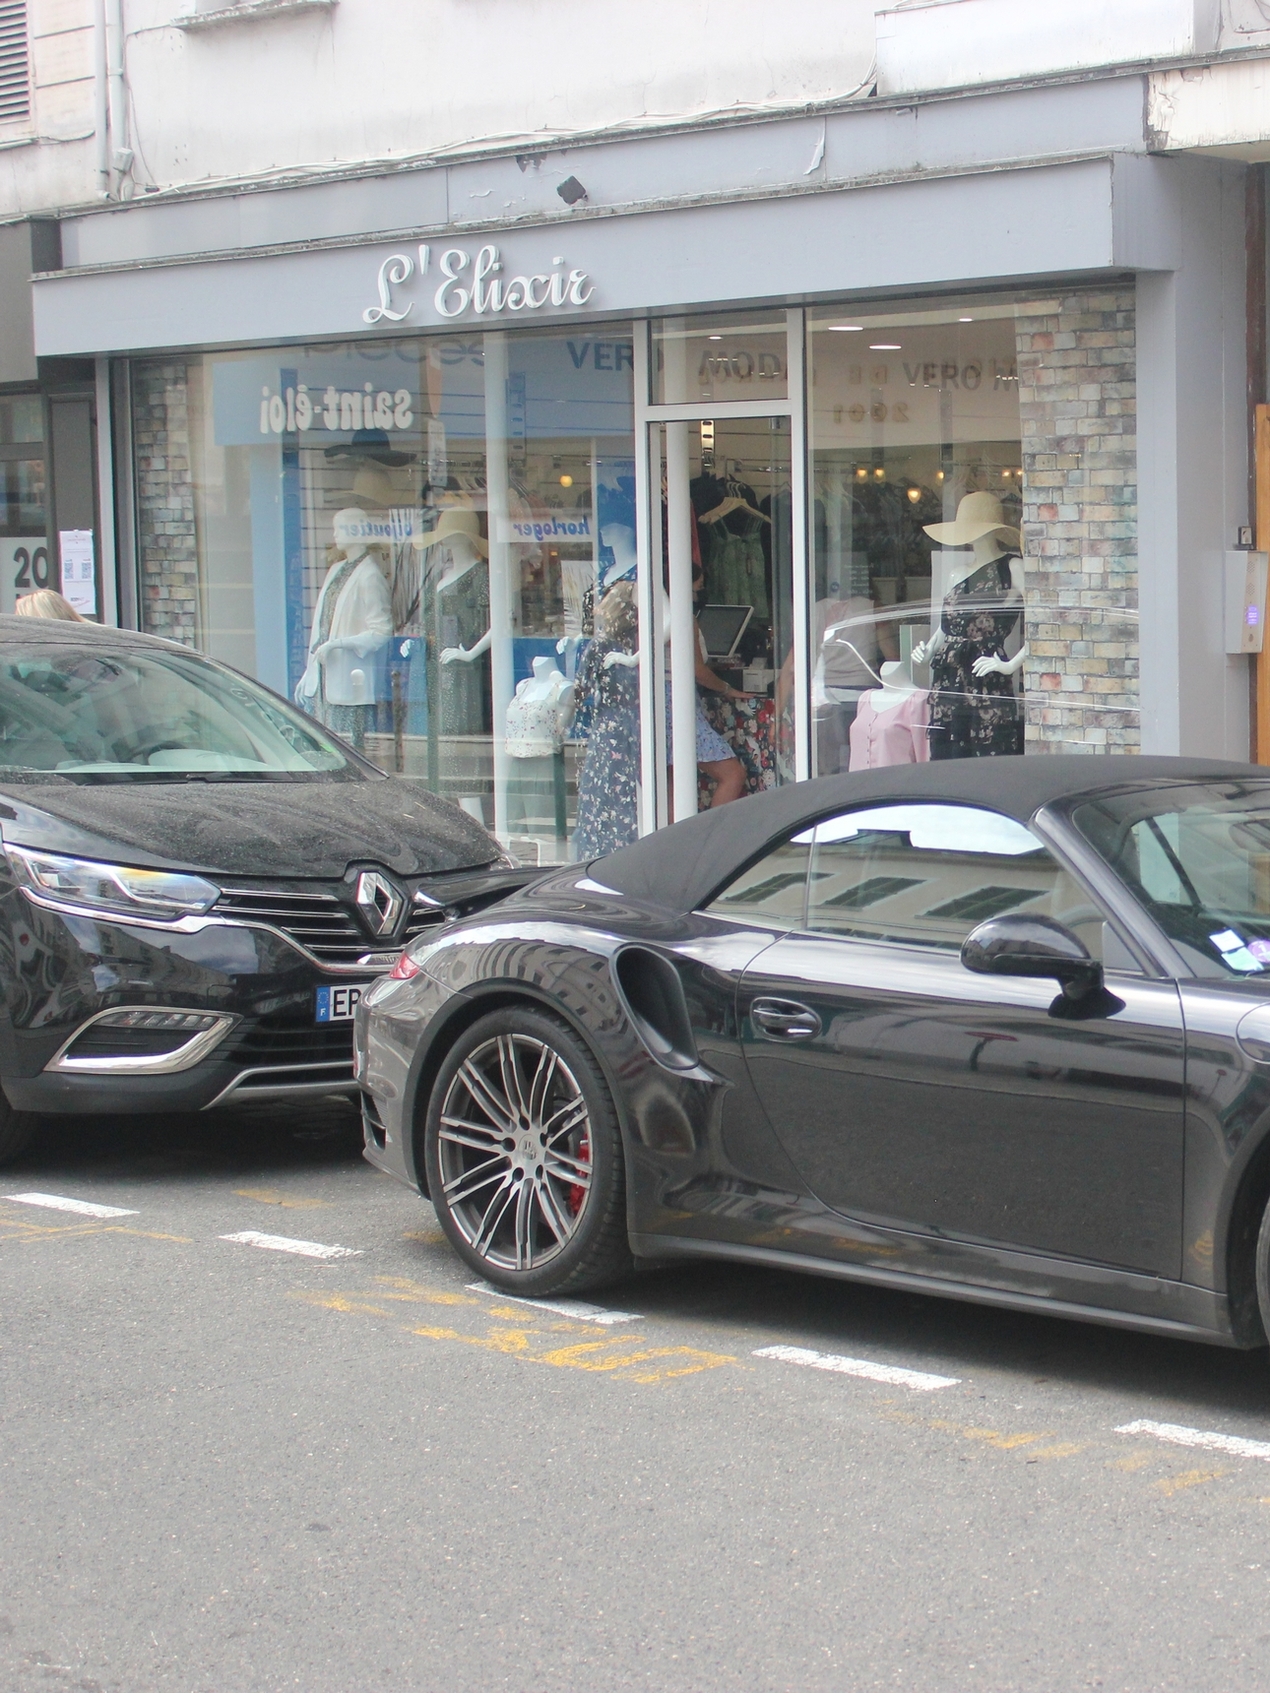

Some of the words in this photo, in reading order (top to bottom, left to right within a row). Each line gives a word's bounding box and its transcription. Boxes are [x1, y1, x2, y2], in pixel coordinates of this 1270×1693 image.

[362, 244, 597, 324] L'Elixir
[13, 546, 49, 589] 20
[333, 988, 362, 1017] EP
